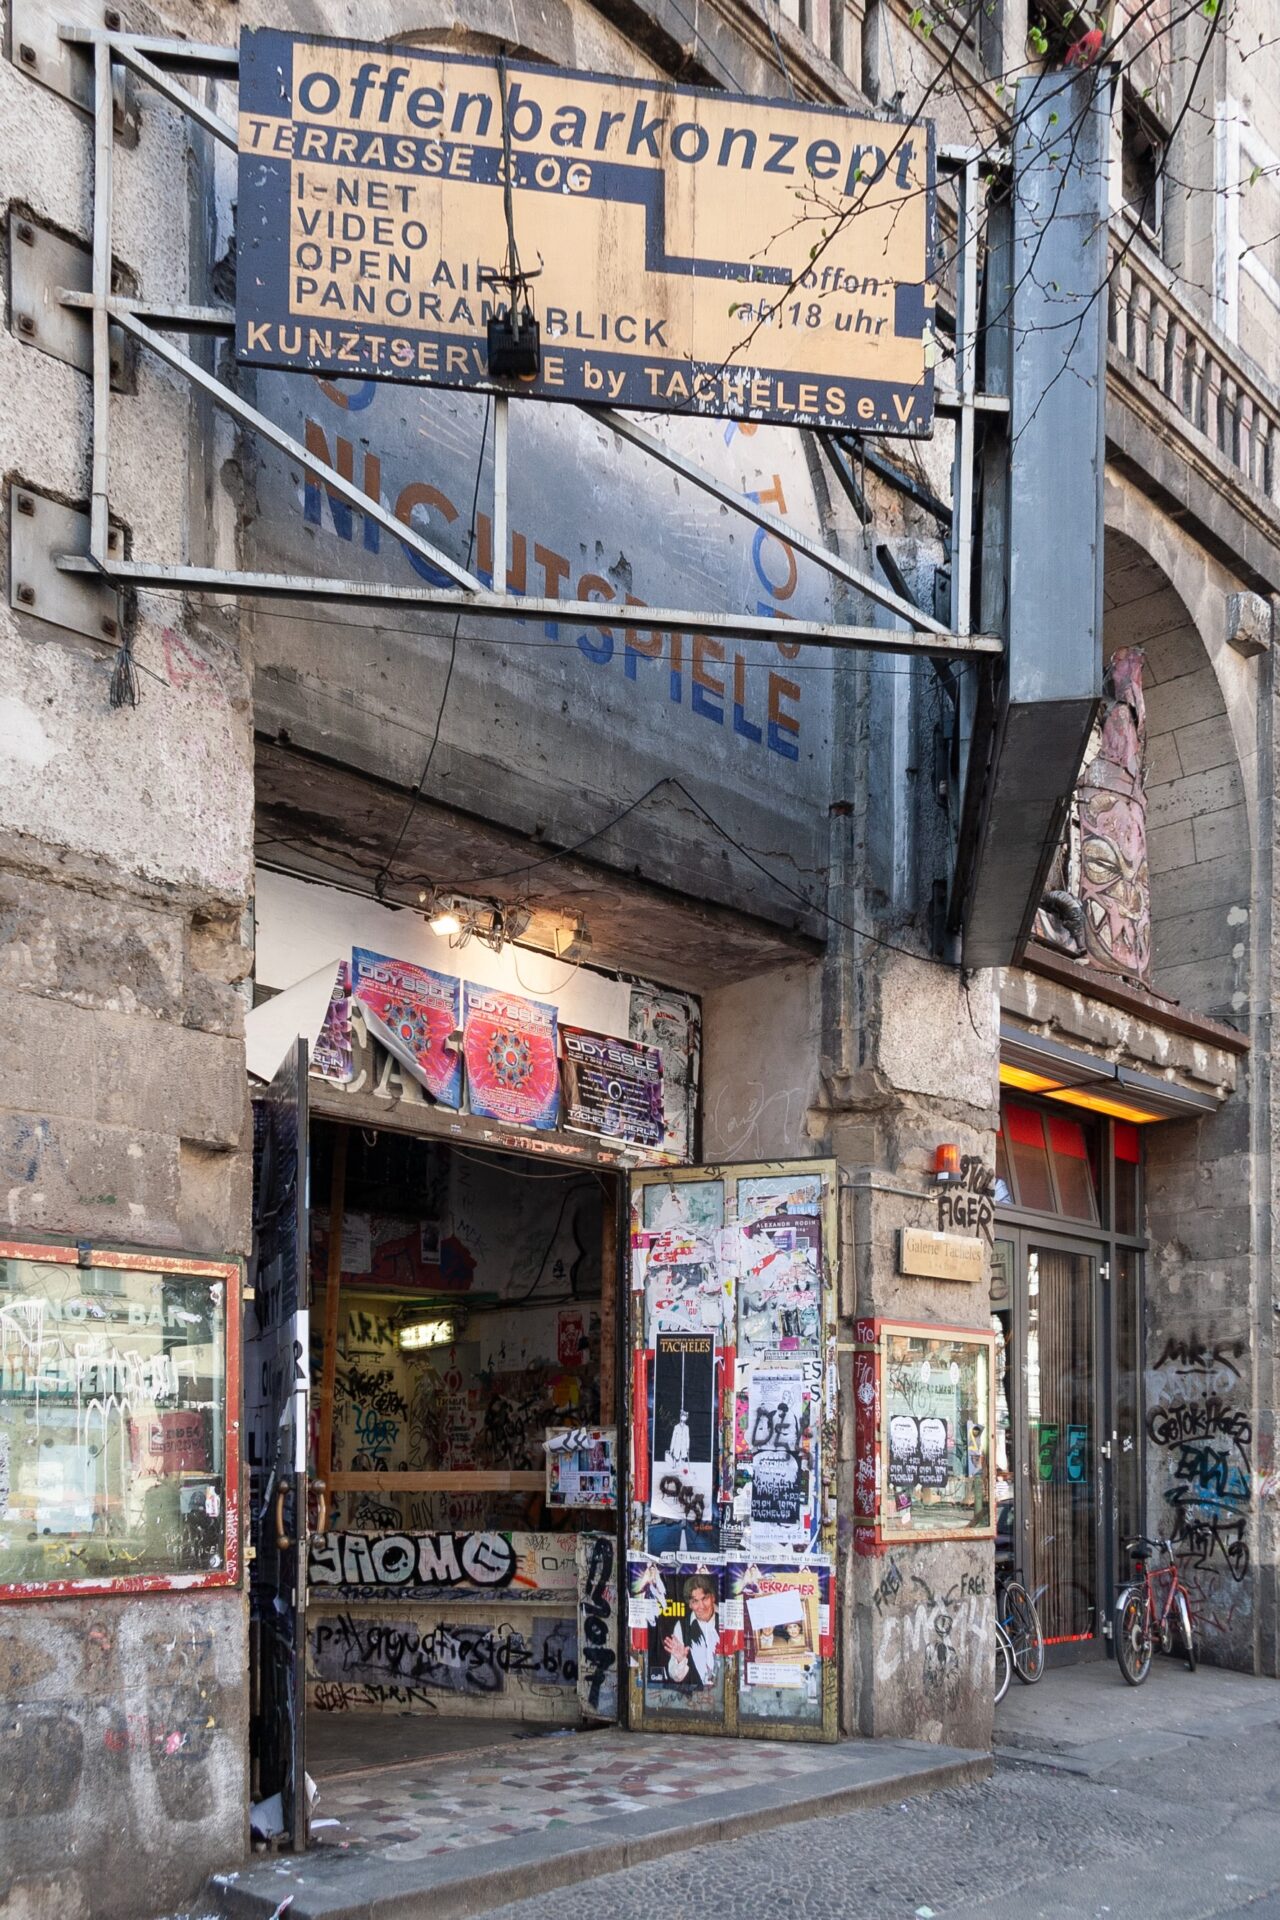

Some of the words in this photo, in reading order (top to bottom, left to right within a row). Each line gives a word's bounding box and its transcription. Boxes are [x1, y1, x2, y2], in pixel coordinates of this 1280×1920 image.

[298, 63, 917, 197] offenbarkonzept
[248, 120, 475, 178] TERRASSE
[497, 154, 593, 192] 5.OG
[297, 172, 416, 213] I-NET
[296, 206, 428, 250] VIDEO
[296, 242, 411, 283] OPEN
[431, 260, 499, 294] AIR
[788, 301, 822, 328] 18
[834, 308, 888, 335] uhr
[584, 361, 626, 399] by
[644, 367, 846, 413] TACHELES
[565, 1037, 658, 1073] ODYSSEE
[661, 1341, 711, 1353] TACHELES
